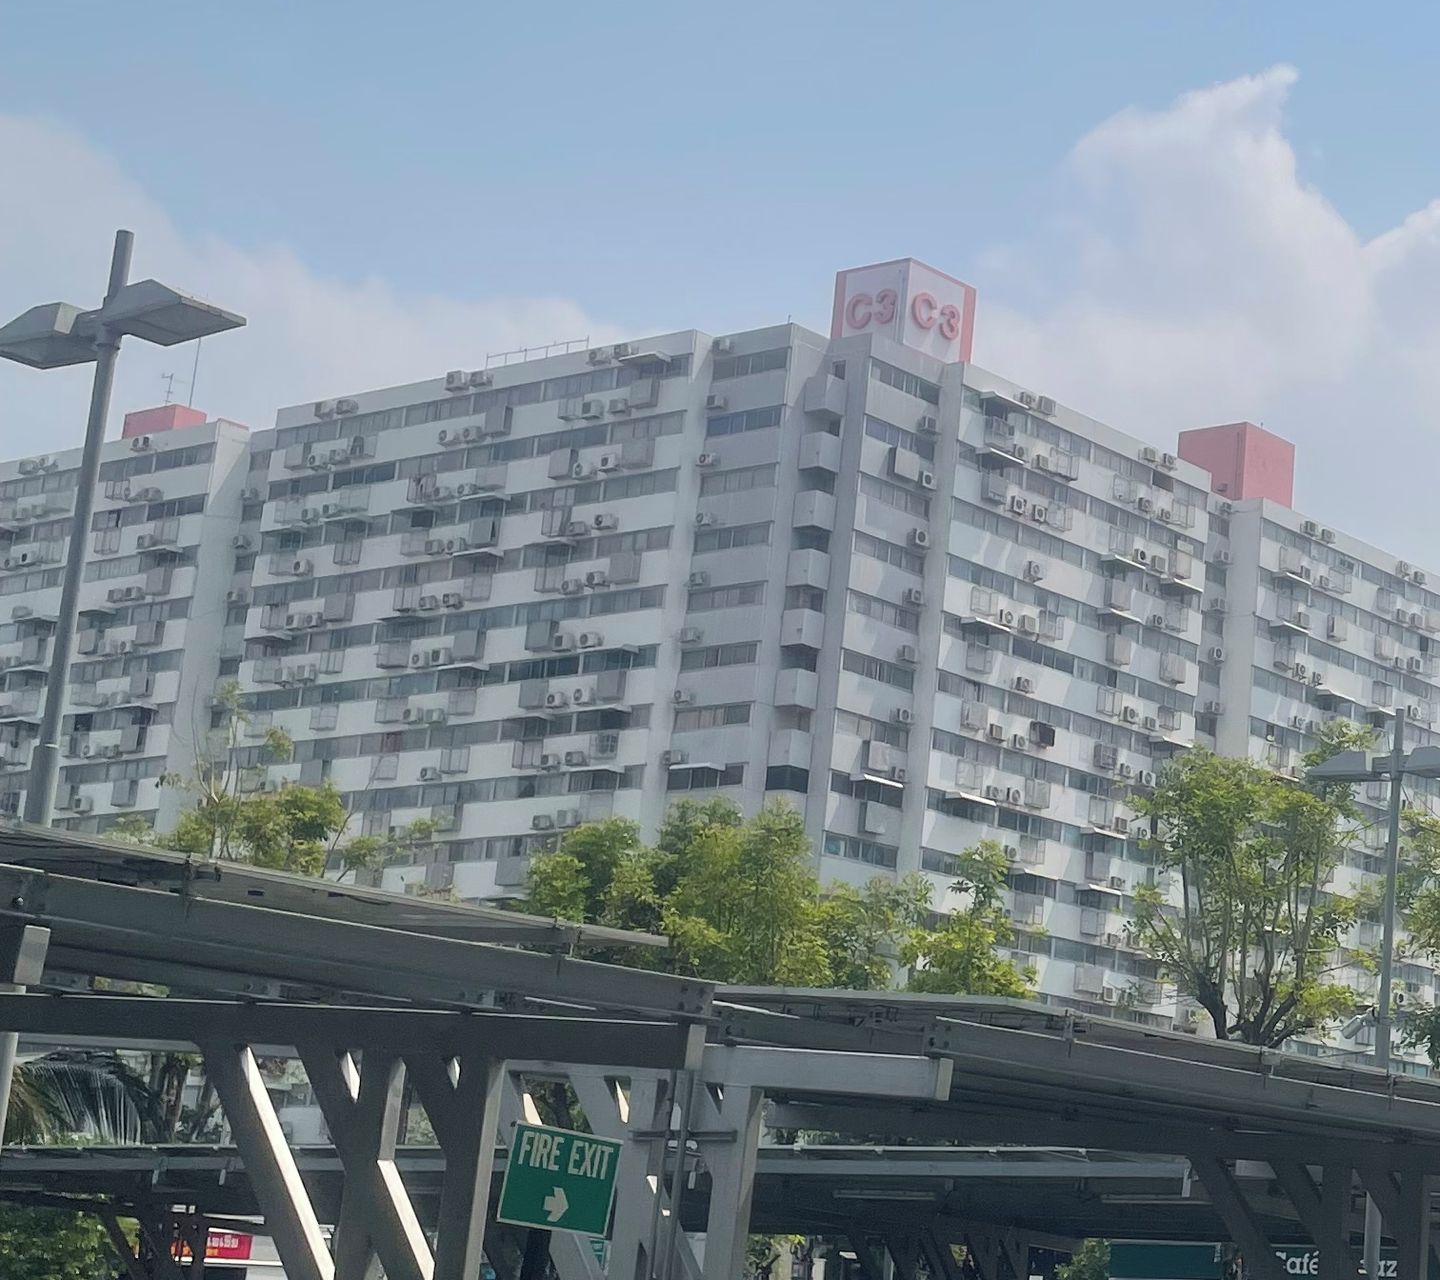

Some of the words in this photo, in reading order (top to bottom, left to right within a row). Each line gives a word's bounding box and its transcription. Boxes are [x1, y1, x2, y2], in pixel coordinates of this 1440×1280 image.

[846, 288, 898, 330] C3
[911, 291, 961, 341] C3
[517, 1130, 565, 1171] FIRE
[567, 1139, 614, 1180] EXIT
